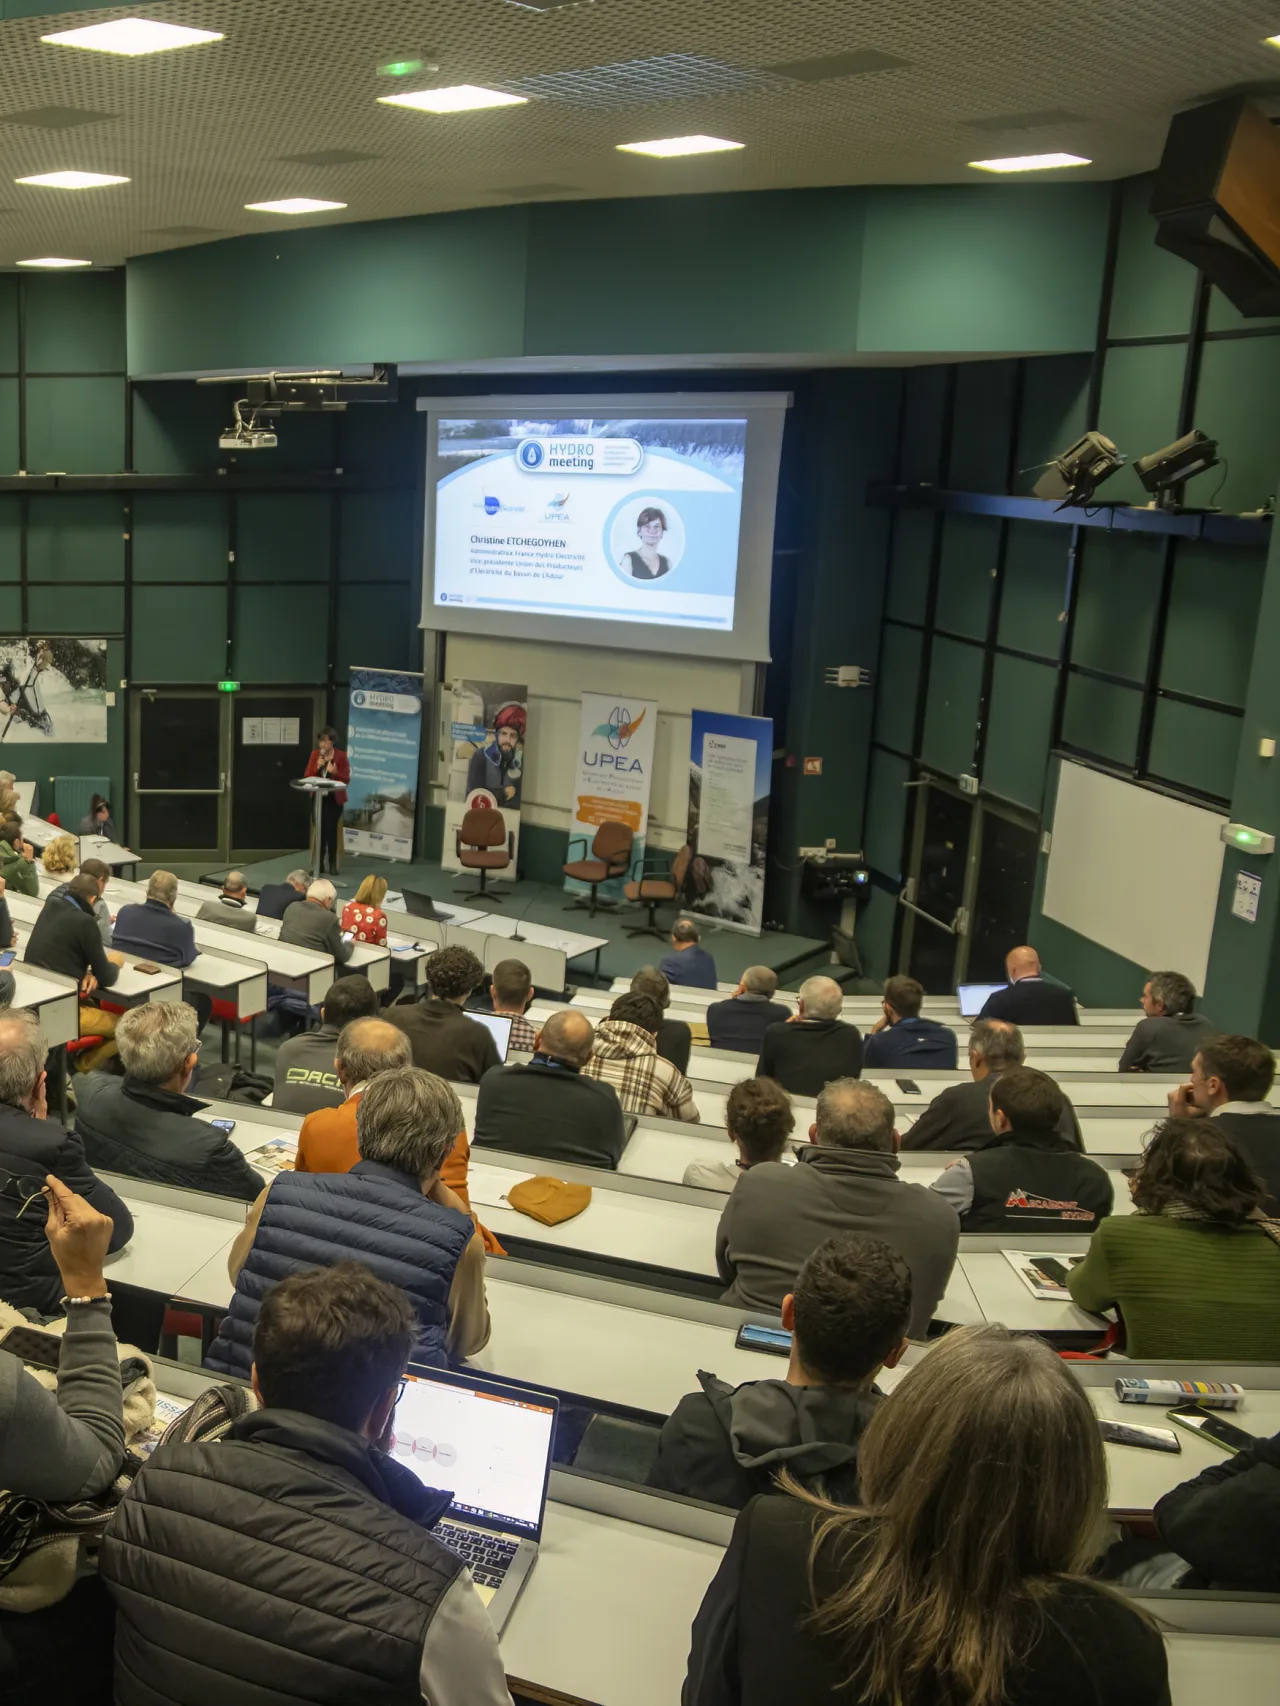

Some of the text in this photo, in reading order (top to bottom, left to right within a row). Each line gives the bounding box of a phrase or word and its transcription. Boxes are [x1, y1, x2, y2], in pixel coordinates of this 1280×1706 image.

[549, 443, 594, 456] HYDRO
[549, 455, 594, 470] meeting
[470, 535, 505, 545] Christine
[583, 751, 643, 775] UPEA
[286, 1067, 341, 1087] DAC
